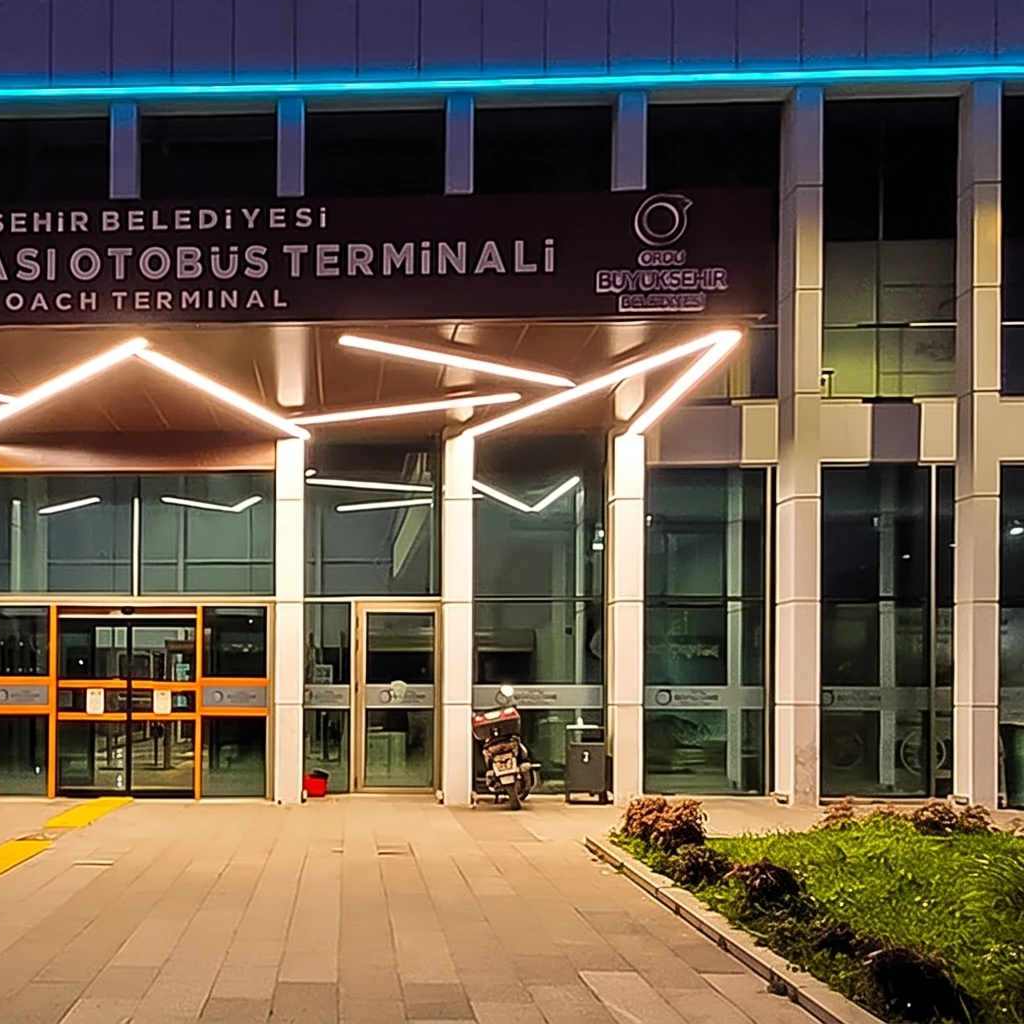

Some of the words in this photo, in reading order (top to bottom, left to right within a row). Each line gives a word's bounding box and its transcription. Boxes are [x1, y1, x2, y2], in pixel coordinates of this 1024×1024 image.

[102, 207, 326, 232] BELEDİYESİ
[70, 245, 269, 280] OTOBÜS
[283, 239, 554, 277] TERMİNALİ
[638, 250, 686, 266] ORDU
[112, 289, 287, 310] TERMINAL
